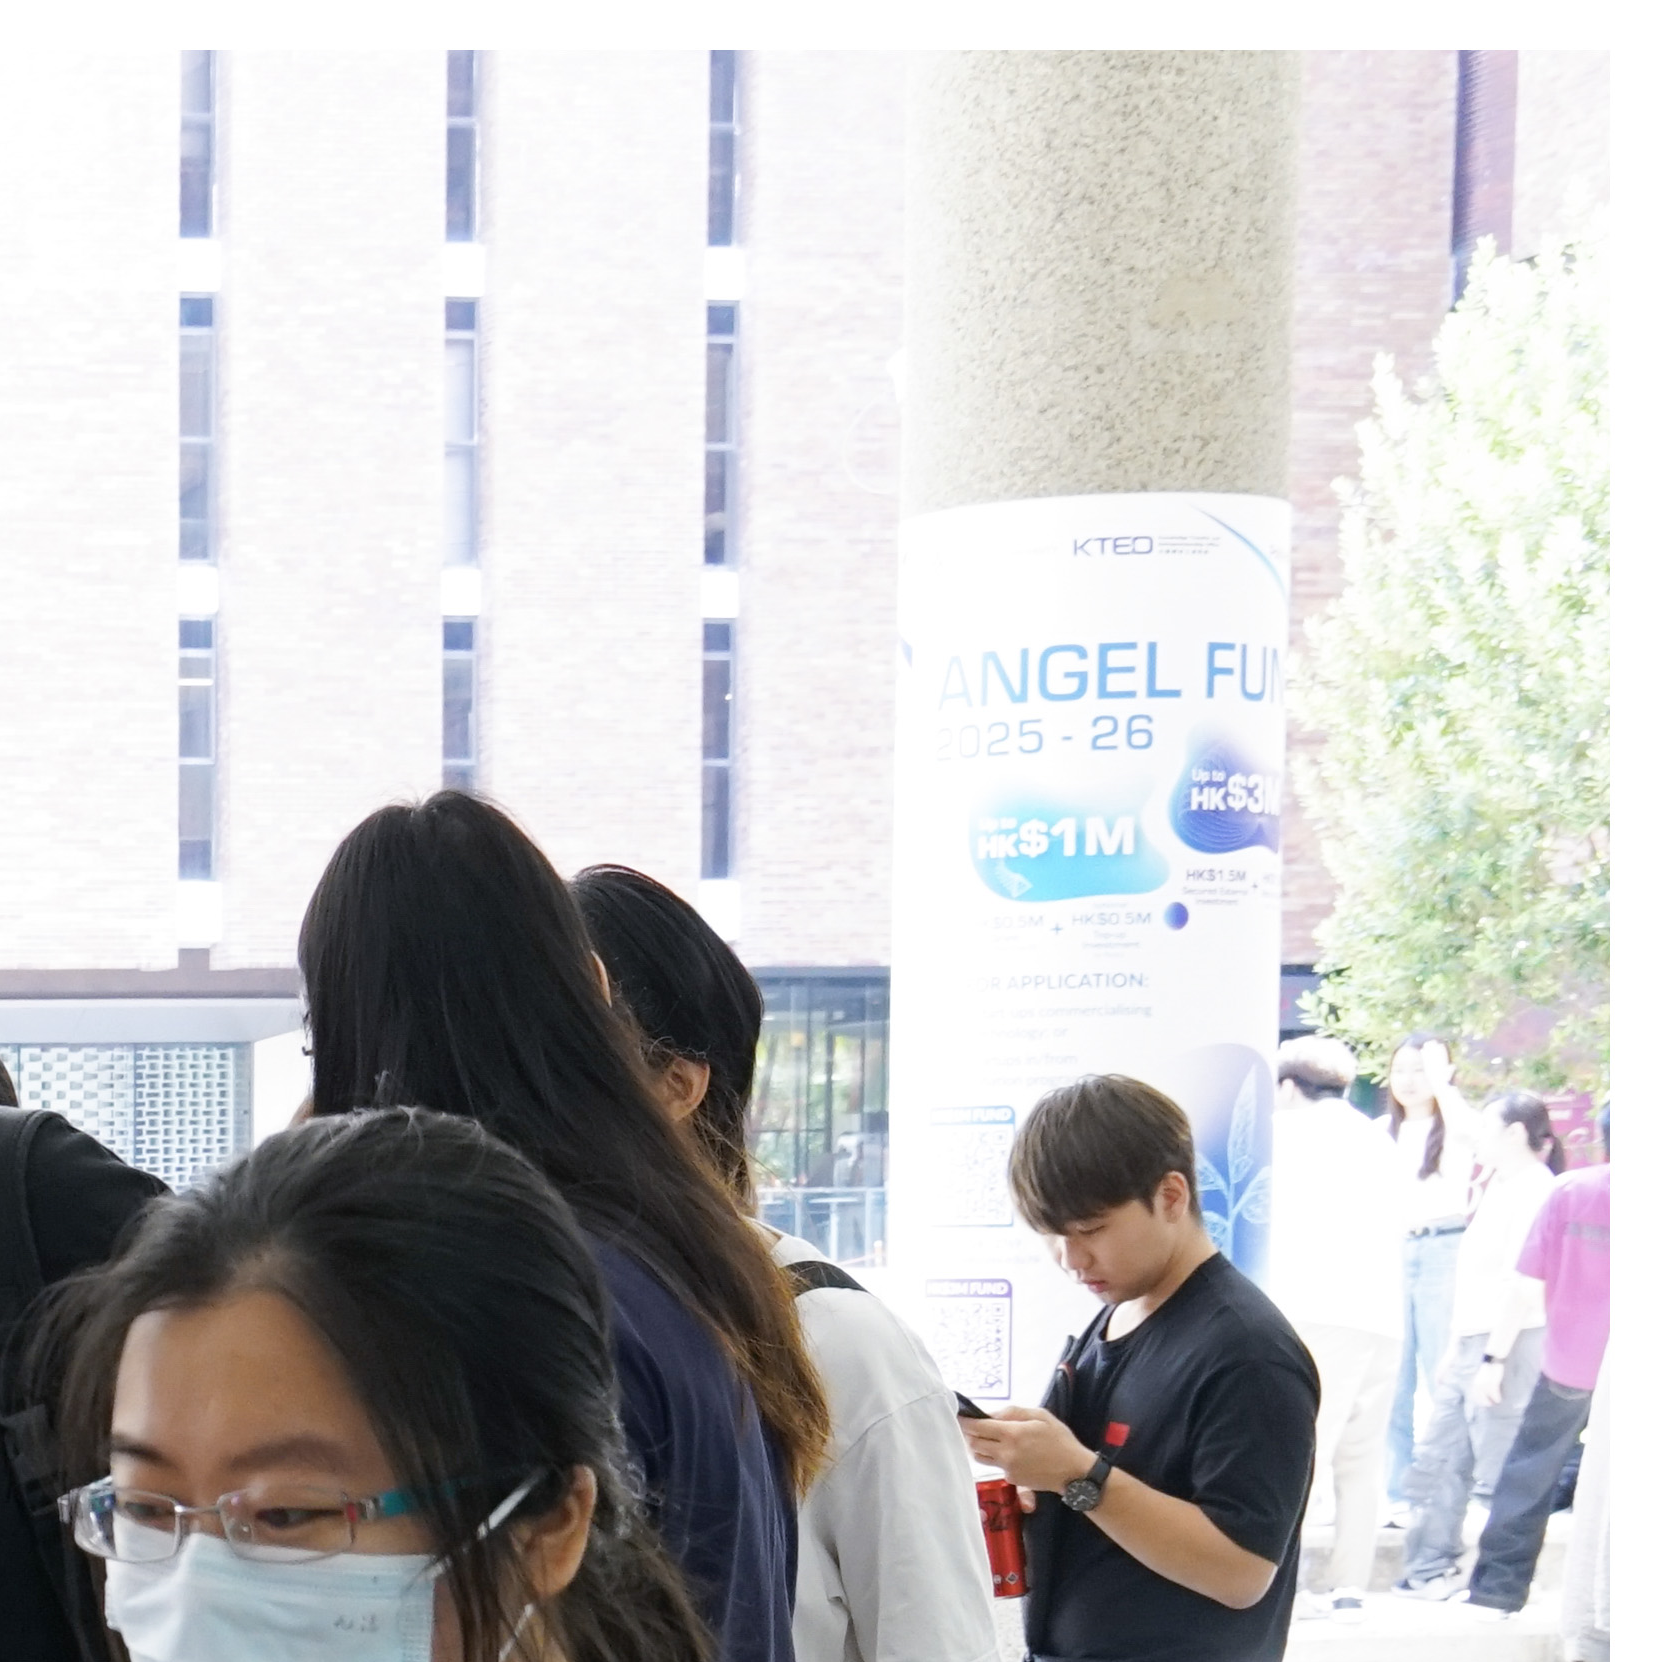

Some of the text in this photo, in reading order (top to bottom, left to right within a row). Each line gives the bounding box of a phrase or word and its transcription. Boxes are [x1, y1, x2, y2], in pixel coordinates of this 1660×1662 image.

[938, 641, 1182, 711] ANGEL
[936, 719, 1045, 762] 2025
[1089, 714, 1154, 750] 26
[1006, 971, 1149, 990] APPLICATION:
